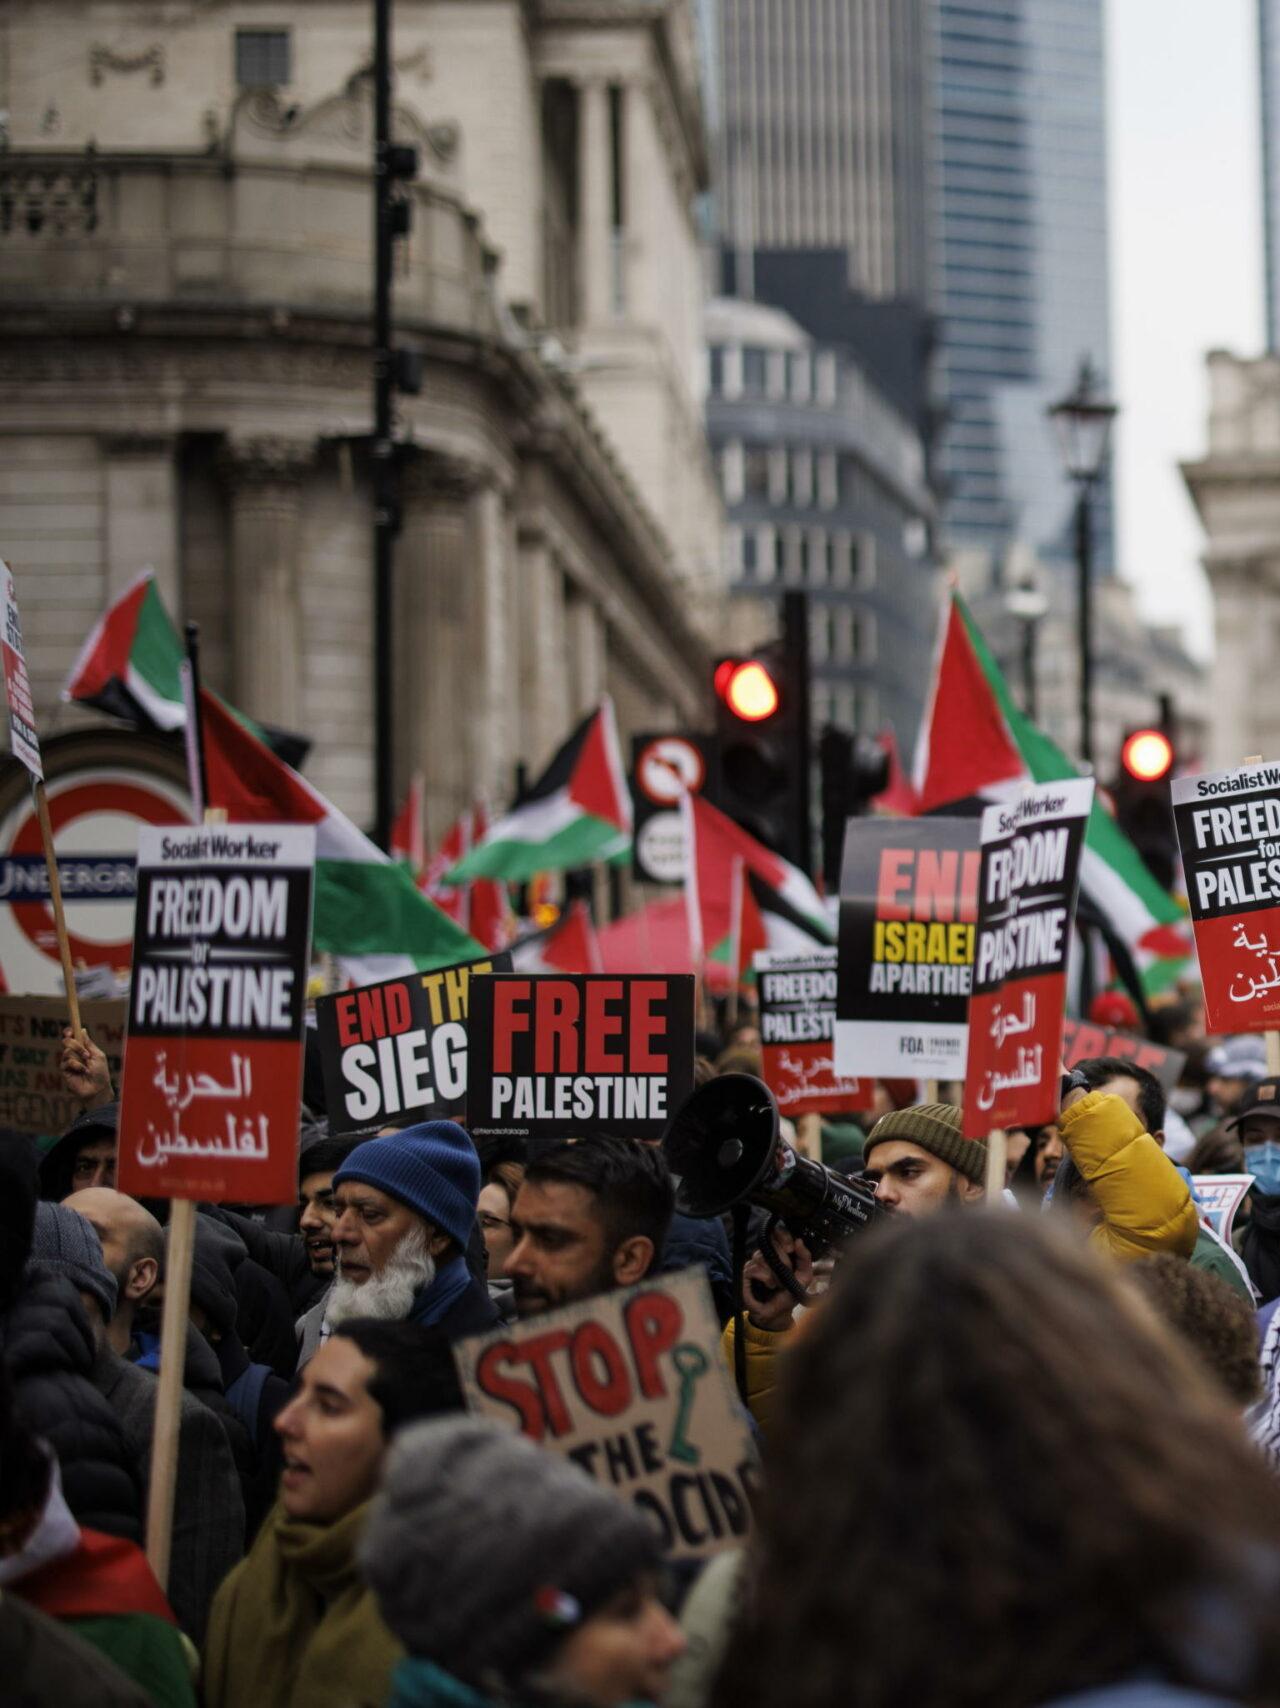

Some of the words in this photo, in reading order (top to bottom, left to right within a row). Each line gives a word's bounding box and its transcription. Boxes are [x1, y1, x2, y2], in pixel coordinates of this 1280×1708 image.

[1197, 772, 1264, 797] Socialist
[211, 833, 282, 859] Worker
[763, 970, 837, 1002] FREEDO
[870, 963, 972, 996] APARTHE
[336, 982, 413, 1048] END
[493, 980, 668, 1073] FREE
[762, 1011, 836, 1041] PALEST
[900, 1035, 924, 1055] FOA
[153, 1050, 253, 1109] الحرية
[341, 1022, 468, 1121] SIEG
[491, 1076, 667, 1119] PALESTINE
[137, 1111, 270, 1167] لفلسطين
[476, 1290, 684, 1443] STOP
[568, 1421, 665, 1484] THE
